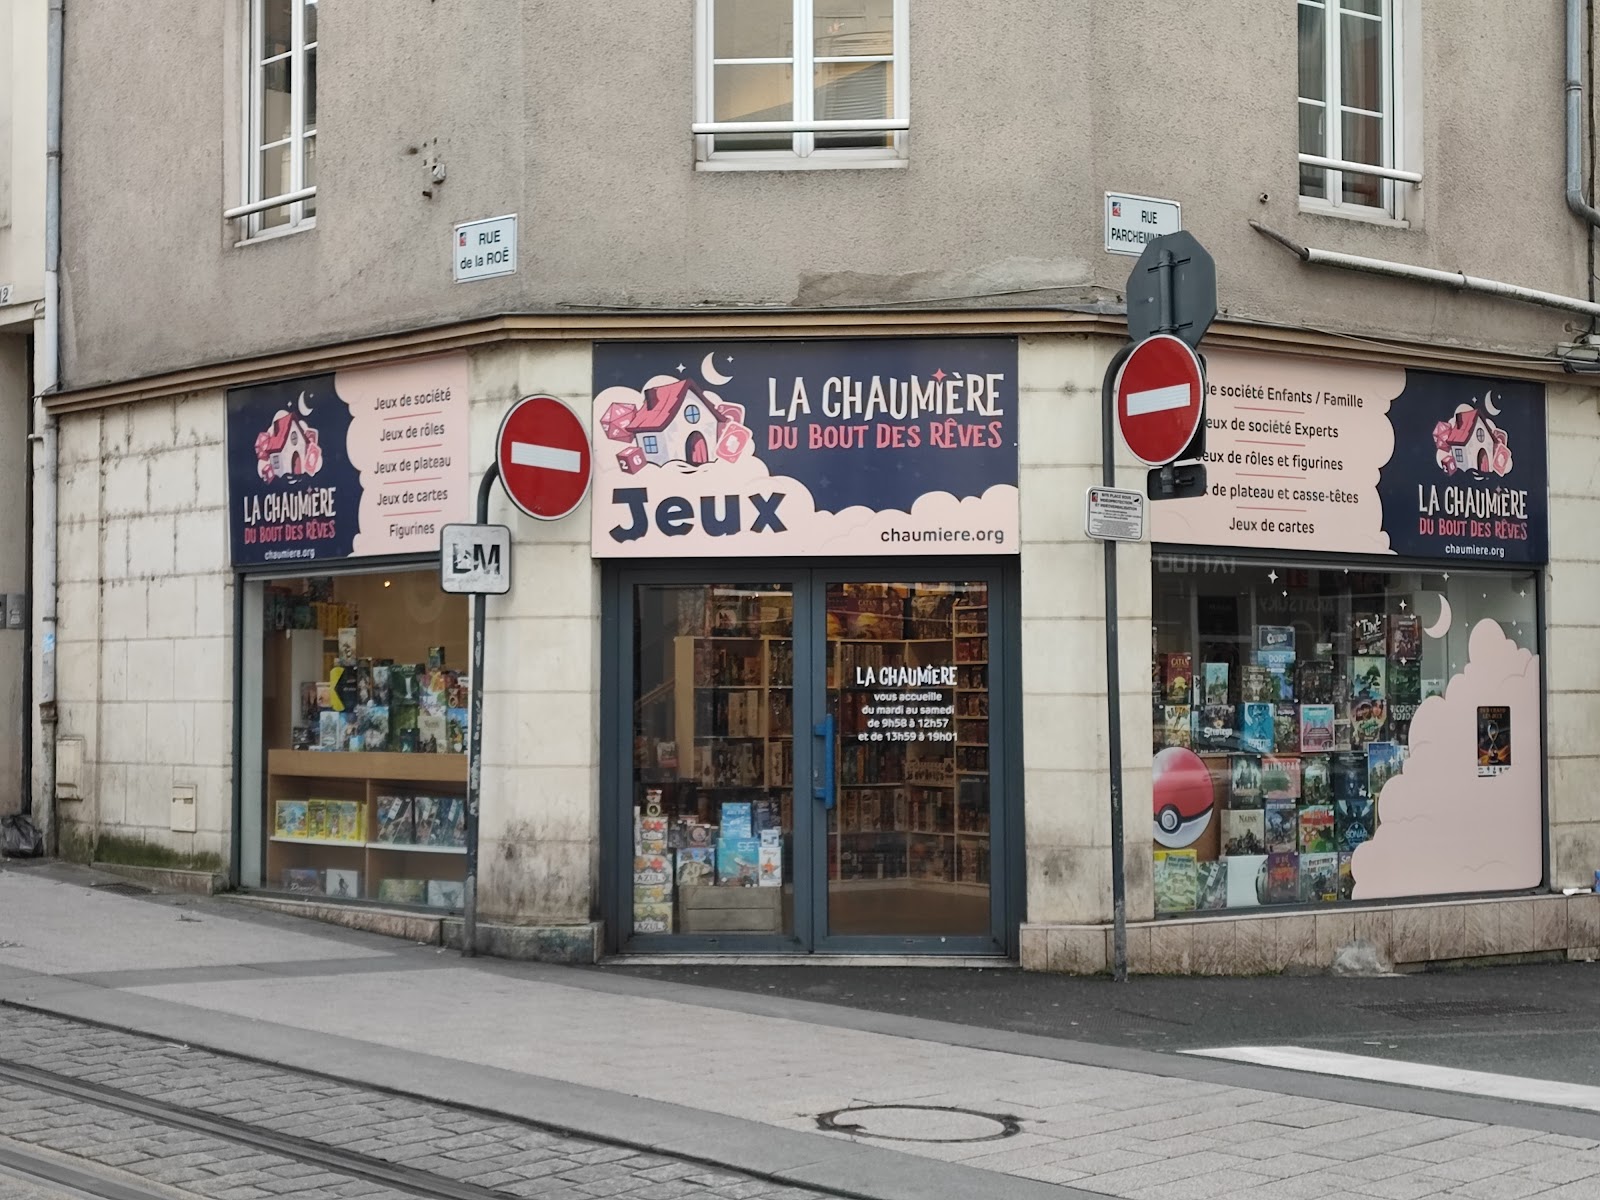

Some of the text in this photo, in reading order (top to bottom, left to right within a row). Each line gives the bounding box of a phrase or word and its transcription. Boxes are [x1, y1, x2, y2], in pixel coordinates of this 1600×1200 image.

[1141, 210, 1158, 225] RUE
[479, 229, 501, 245] RUE
[460, 257, 473, 270] de
[475, 255, 484, 267] la
[373, 387, 451, 411] Jeux de société
[768, 370, 1005, 423] LA CHAUMIÈRE
[1220, 384, 1264, 400] société
[1267, 386, 1313, 404] Enfants
[1315, 391, 1321, 404] /
[1323, 392, 1364, 408] Famille
[379, 422, 445, 442] Jeux de rôles
[768, 417, 1003, 450] DU BOUT DES RÊVES
[1205, 417, 1339, 440] eux de société Experts
[373, 455, 451, 475] Jeux de plateau
[632, 454, 643, 466] 6
[1227, 450, 1243, 464] de
[1245, 452, 1274, 467] rôles
[1277, 454, 1290, 467] et
[1292, 454, 1344, 471] figurines
[376, 488, 449, 506] Jeux de cartes
[1211, 483, 1227, 497] de
[1230, 483, 1275, 500] plateau
[1277, 487, 1290, 500] et
[1292, 488, 1359, 504] casse-têtes
[1418, 483, 1529, 520] LA CHAUMIÈRE
[243, 486, 337, 526] LA CHAUMIÈRE
[608, 487, 788, 544] Jeux
[244, 518, 336, 545] DU BOUT DES RÊVES
[388, 521, 436, 540] Figurines
[880, 527, 1004, 544] chaumiere.org
[1229, 517, 1315, 534] Jeux de cartes
[1419, 516, 1529, 541] DU BOUT DES RÊVES
[264, 548, 316, 560] chaumiere.org
[1445, 543, 1505, 558] chaumiere.org
[856, 665, 876, 687] LA
[874, 691, 943, 702] vous accueille
[861, 705, 955, 715] du mardi au samedi
[867, 718, 880, 728] de
[881, 718, 908, 728] 9h58
[918, 719, 950, 728] 12h57
[857, 732, 869, 741] et
[870, 732, 883, 741] de
[885, 732, 917, 741] 13h59
[927, 732, 958, 741] 19h01
